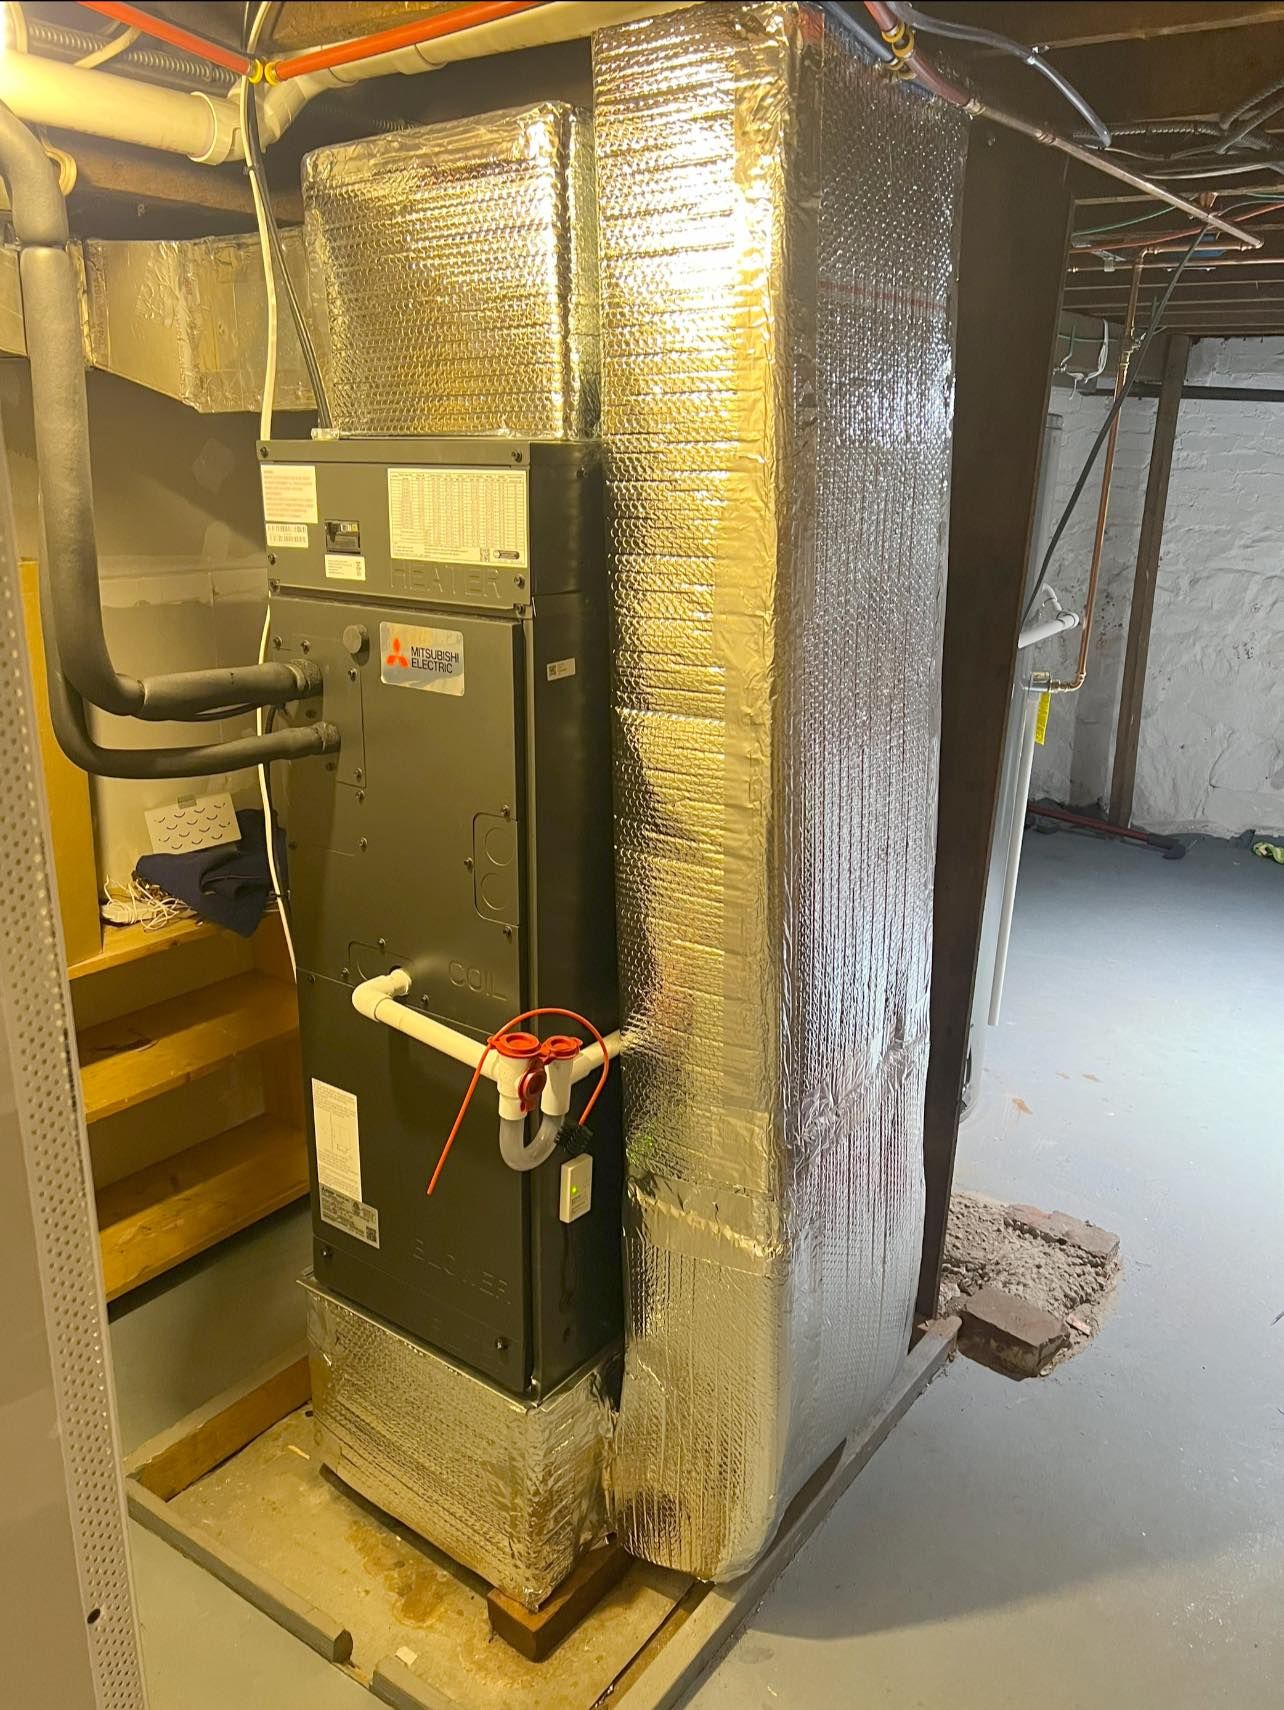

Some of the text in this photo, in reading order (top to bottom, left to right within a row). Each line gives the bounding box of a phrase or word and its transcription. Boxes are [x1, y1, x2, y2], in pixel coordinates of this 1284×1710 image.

[391, 563, 502, 599] HEATER
[410, 645, 460, 664] MITSUBISHI
[411, 657, 453, 674] ELECTRIC
[448, 957, 508, 1001] COIL
[411, 1236, 512, 1305] BLOER
